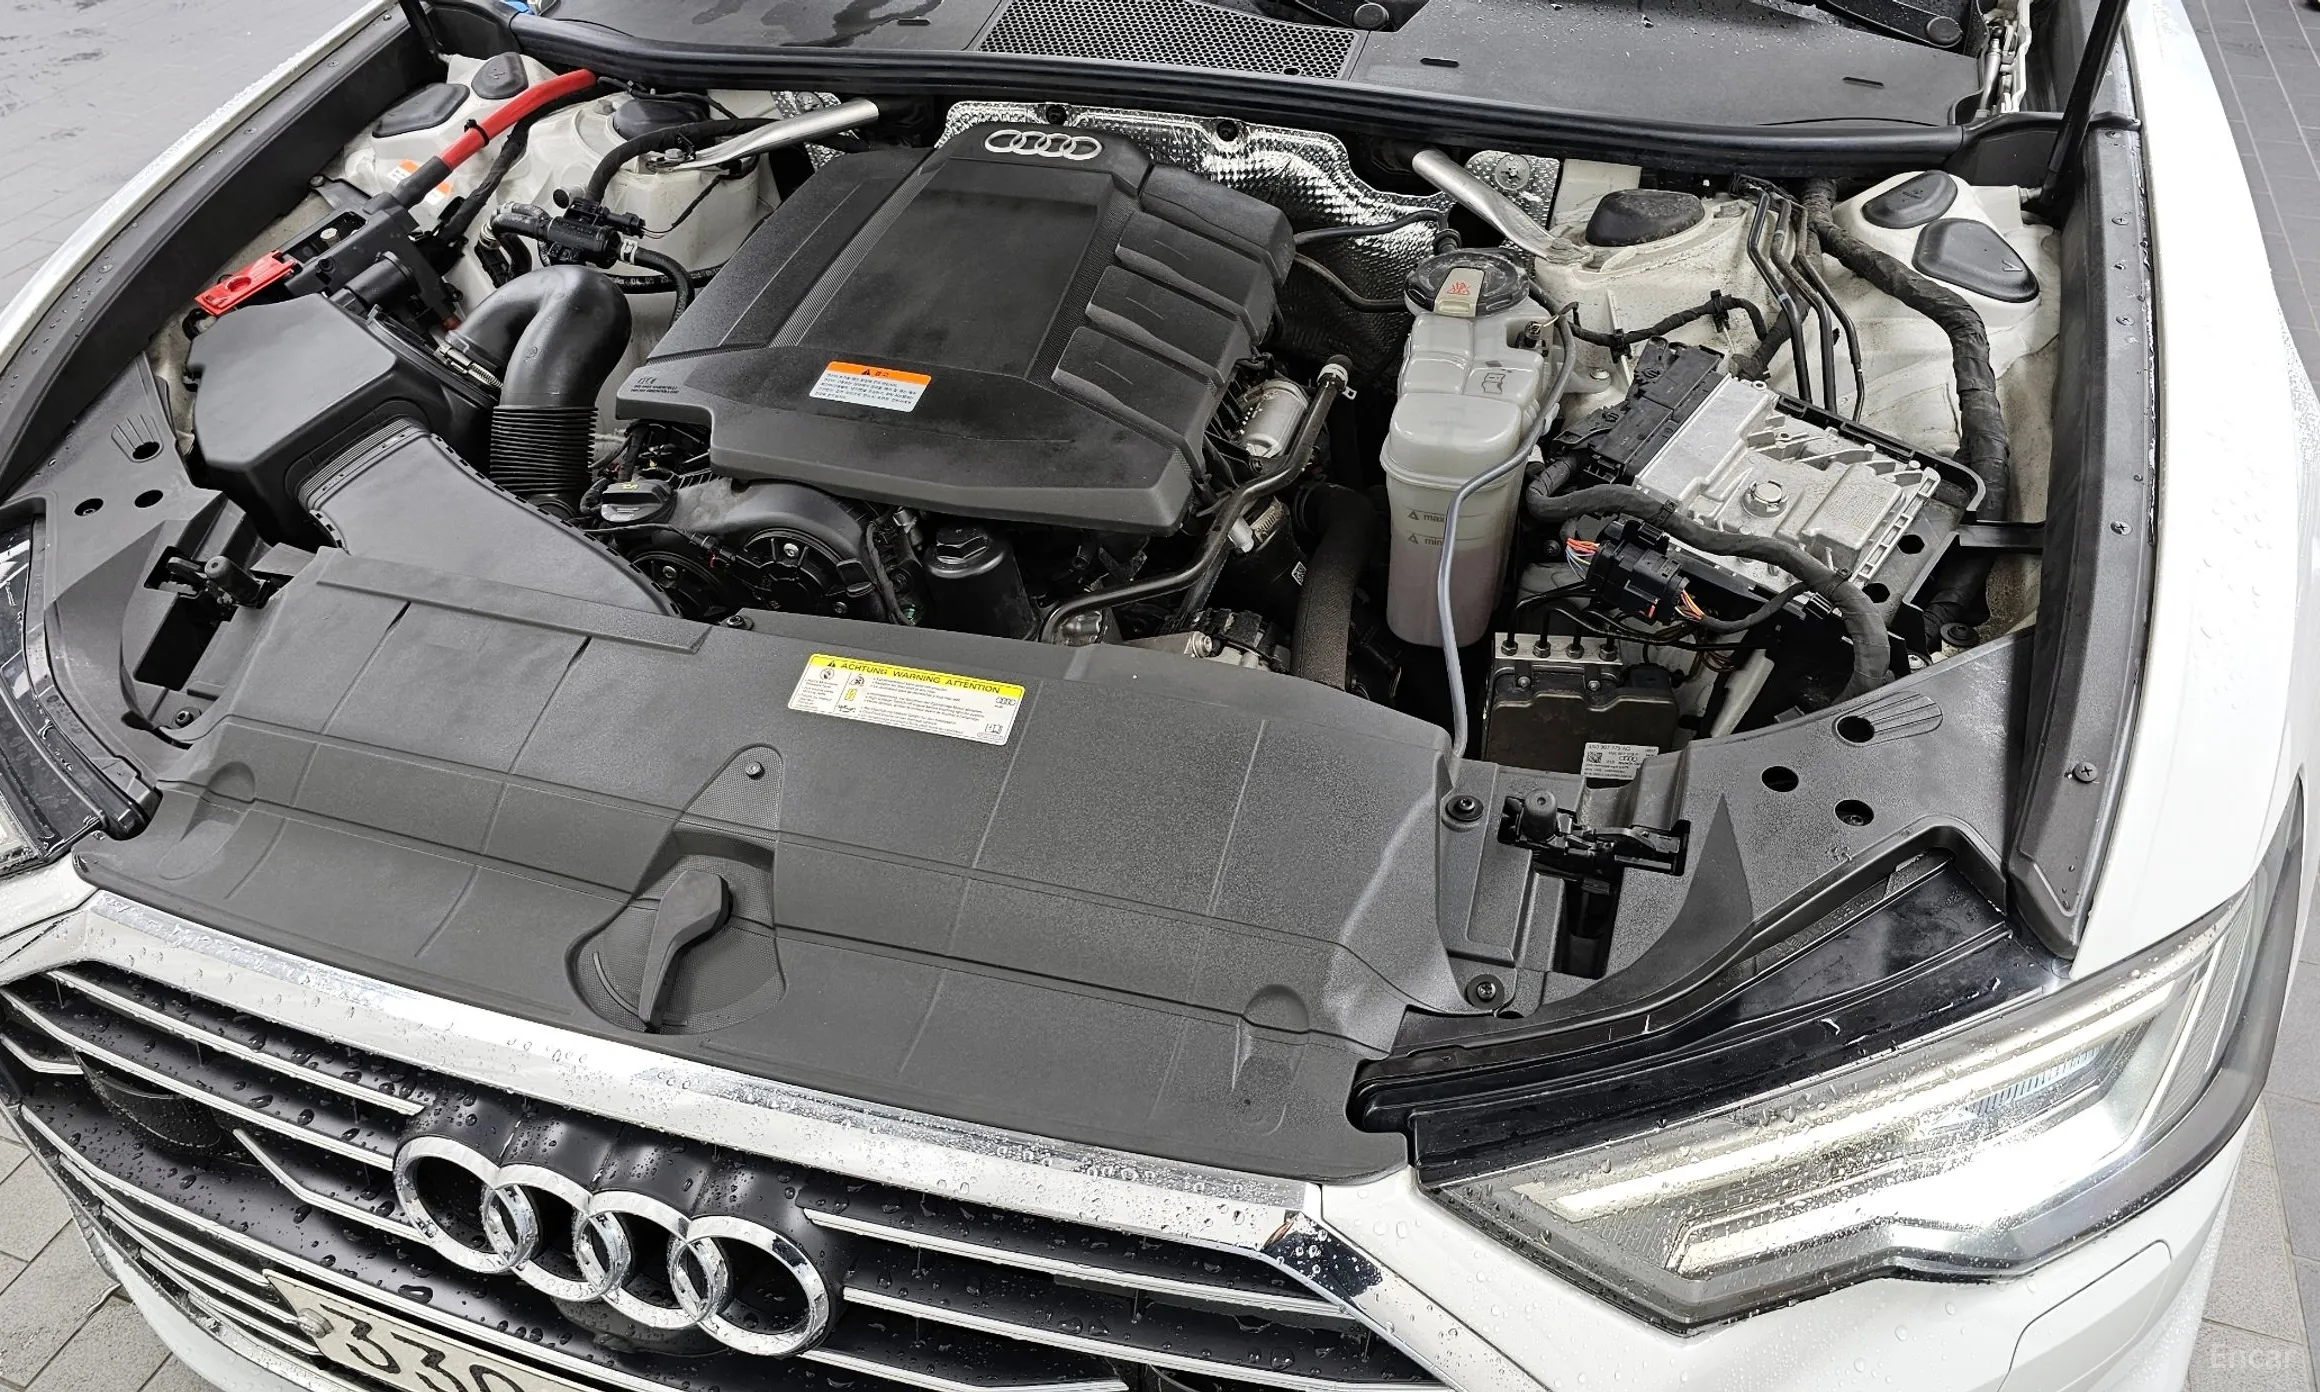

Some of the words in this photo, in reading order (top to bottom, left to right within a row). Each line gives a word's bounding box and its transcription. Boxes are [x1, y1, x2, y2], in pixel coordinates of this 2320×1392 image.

[1423, 513, 1446, 523] max
[840, 662, 888, 676] ACHTUNG
[892, 670, 941, 684] WARNING
[945, 678, 1001, 694] ATTENTION
